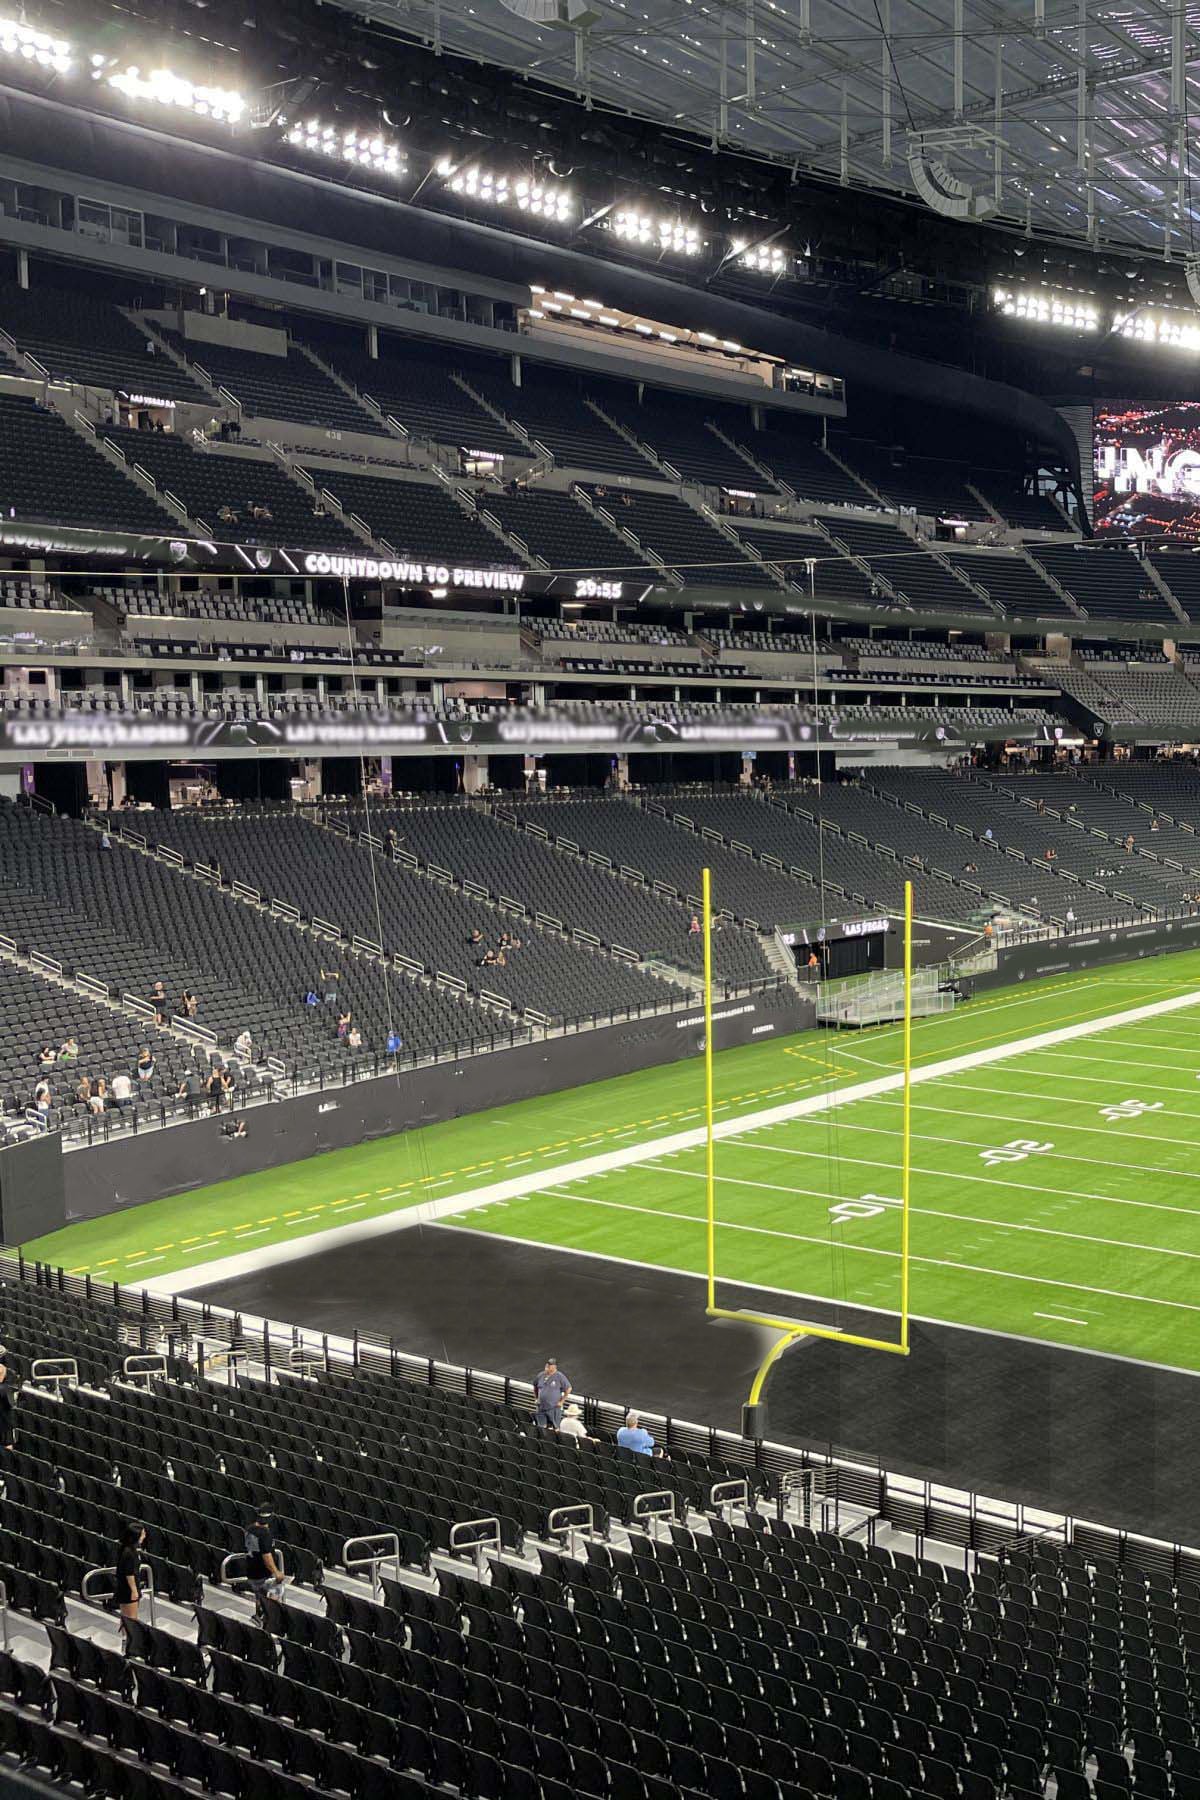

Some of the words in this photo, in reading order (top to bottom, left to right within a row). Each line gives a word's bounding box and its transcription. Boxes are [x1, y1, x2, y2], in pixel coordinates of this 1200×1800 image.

[305, 554, 422, 583] COUNTDOWN
[426, 565, 450, 584] TO
[453, 568, 524, 591] PREVIEW
[574, 580, 623, 598] 29:55
[978, 1140, 1055, 1162] 20
